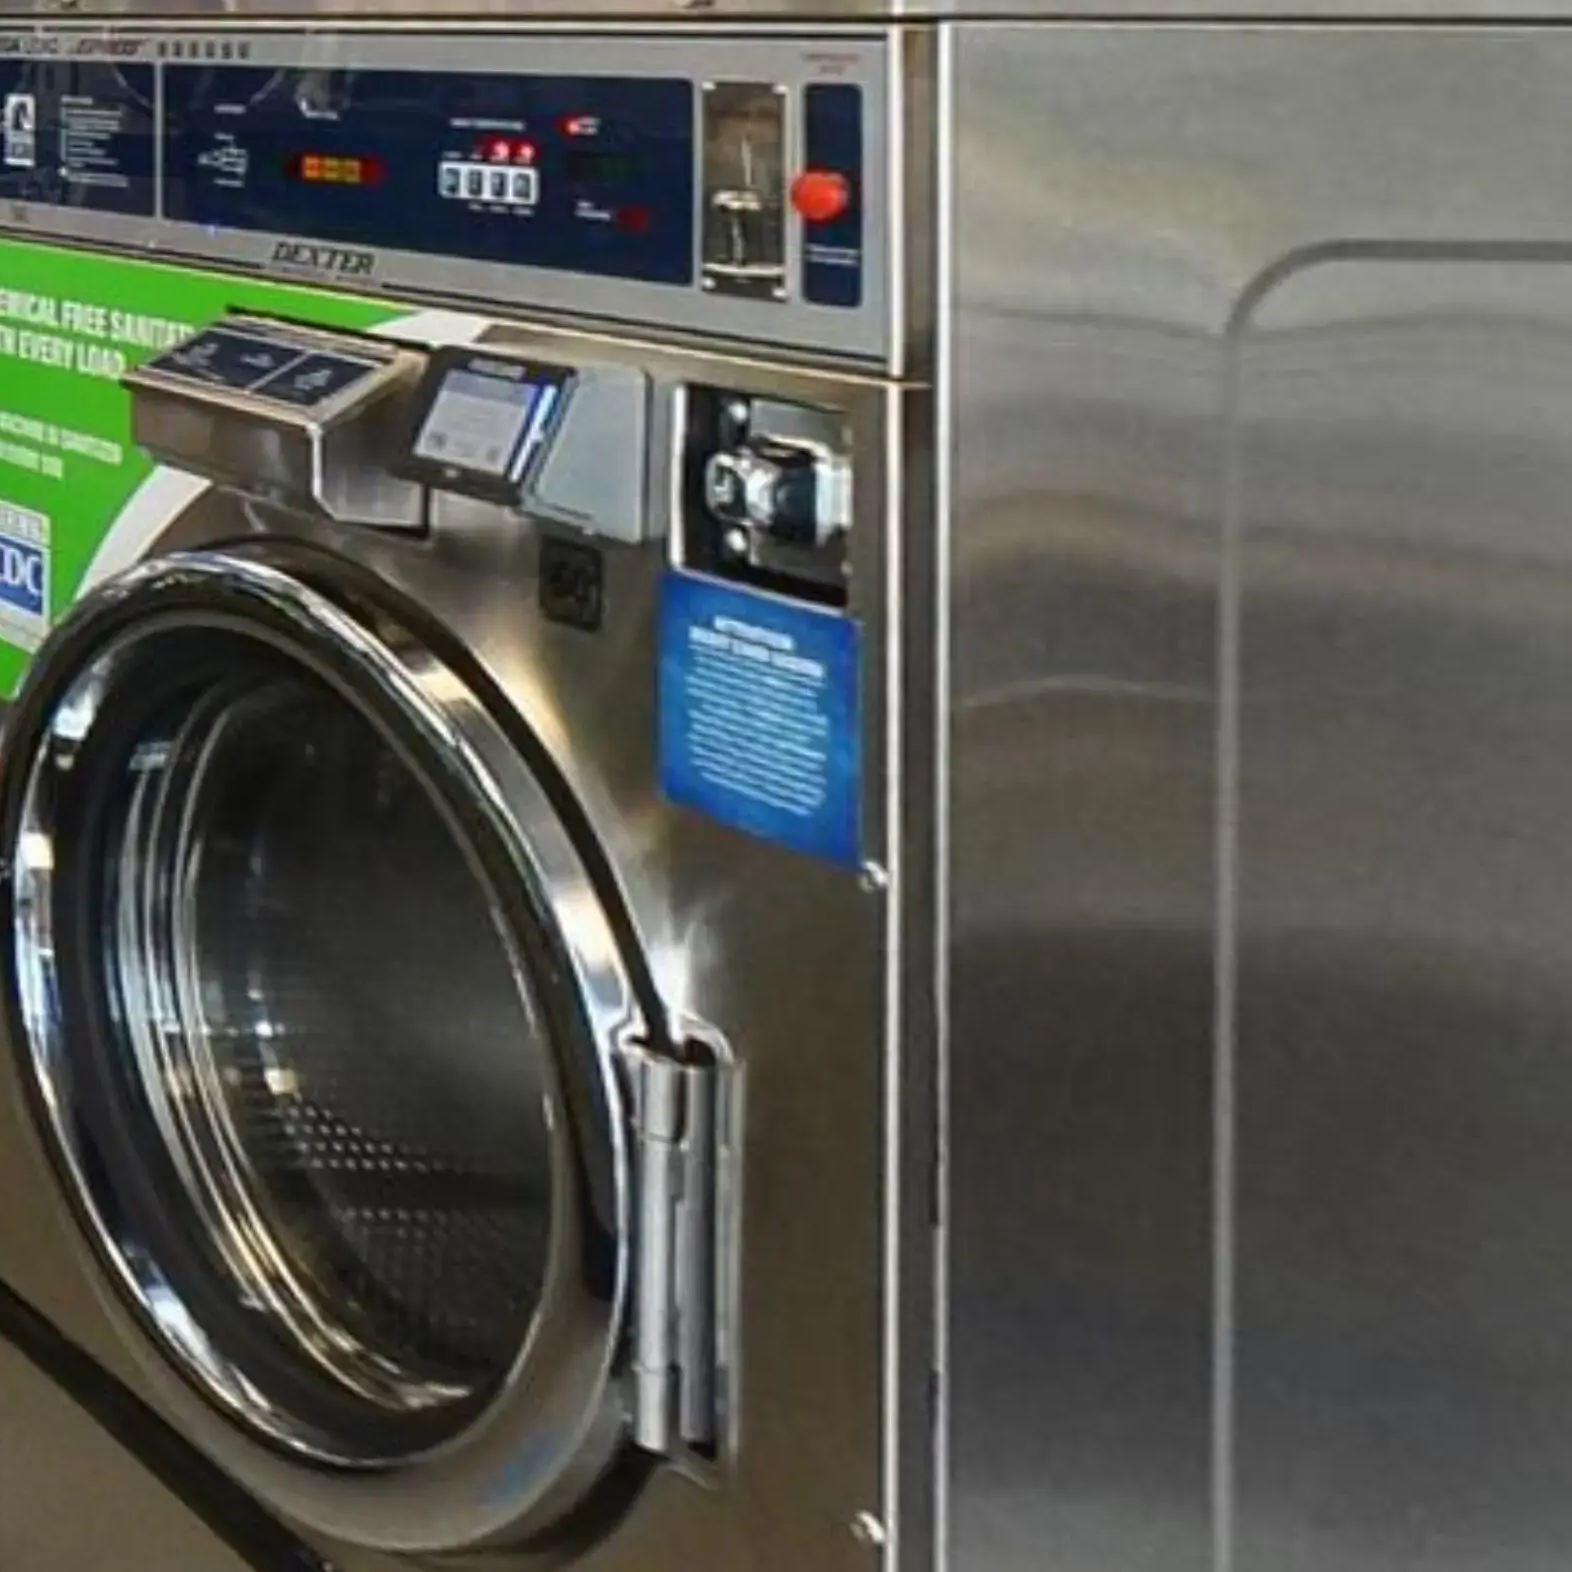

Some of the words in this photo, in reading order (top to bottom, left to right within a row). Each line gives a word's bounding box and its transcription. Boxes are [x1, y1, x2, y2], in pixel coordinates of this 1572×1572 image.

[270, 240, 378, 276] DEXTER
[61, 299, 110, 340] FREE
[18, 328, 74, 371] EVERY
[76, 341, 127, 381] LOAD
